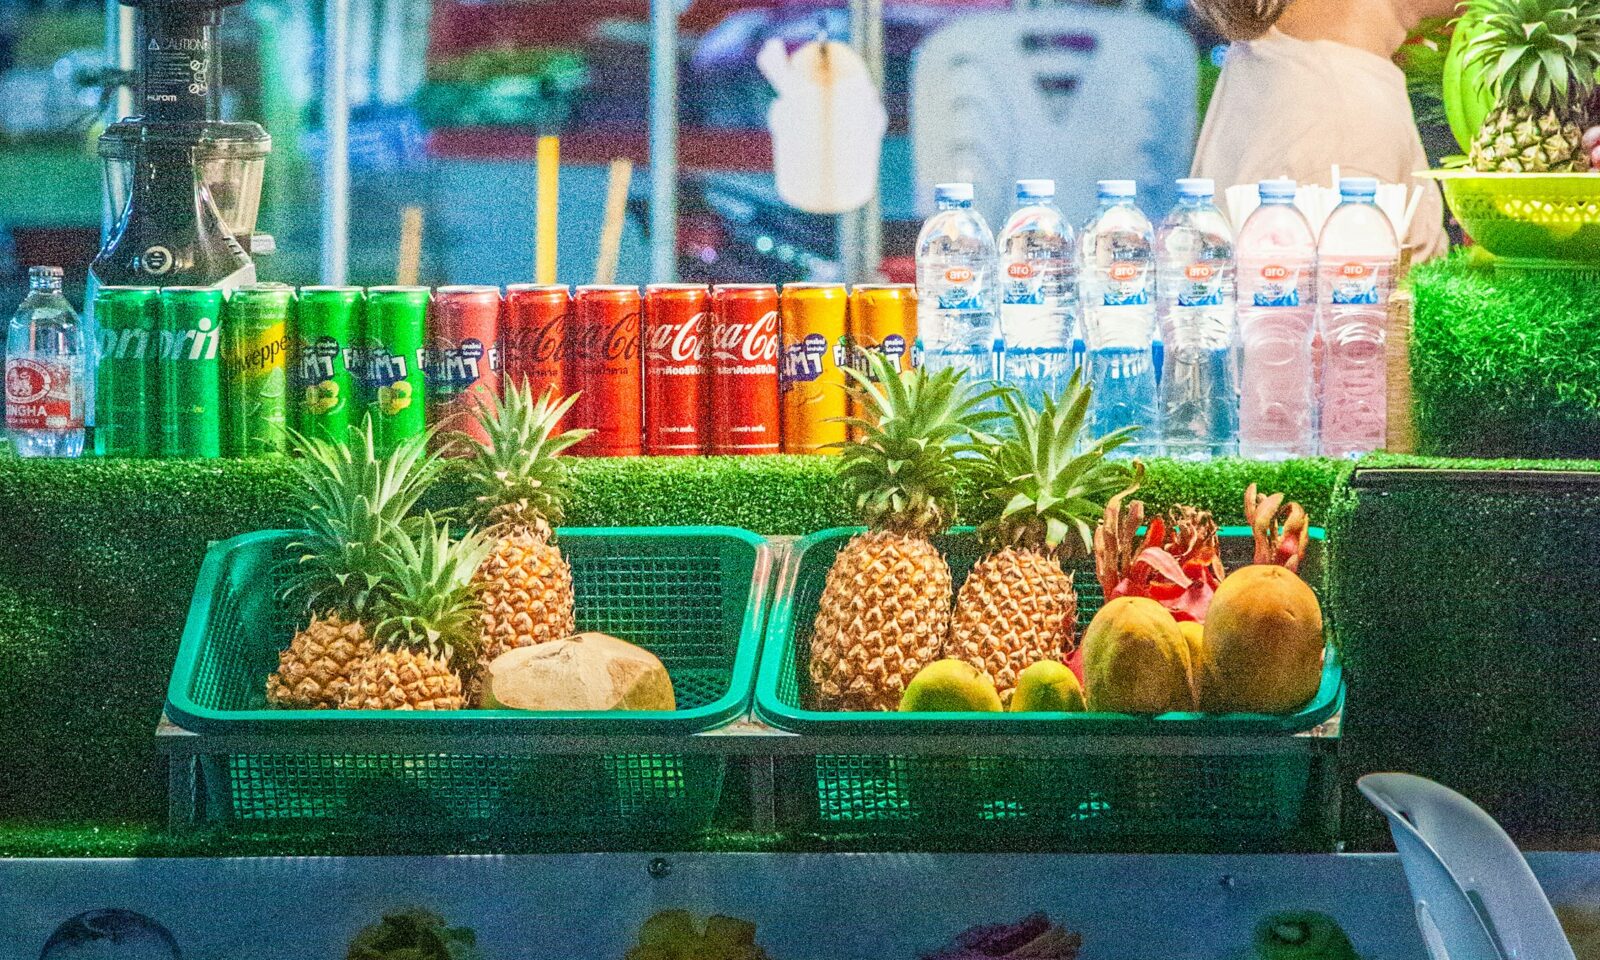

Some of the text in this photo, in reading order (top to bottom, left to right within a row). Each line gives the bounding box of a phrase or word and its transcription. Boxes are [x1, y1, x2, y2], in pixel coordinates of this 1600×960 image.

[949, 270, 971, 280] aro
[1010, 266, 1030, 275] aro
[1114, 266, 1135, 276] aro
[1189, 267, 1209, 276] aro
[1264, 268, 1285, 277] aro
[1343, 265, 1363, 275] aro
[160, 317, 223, 360] prit
[6, 405, 47, 416] INGHA
